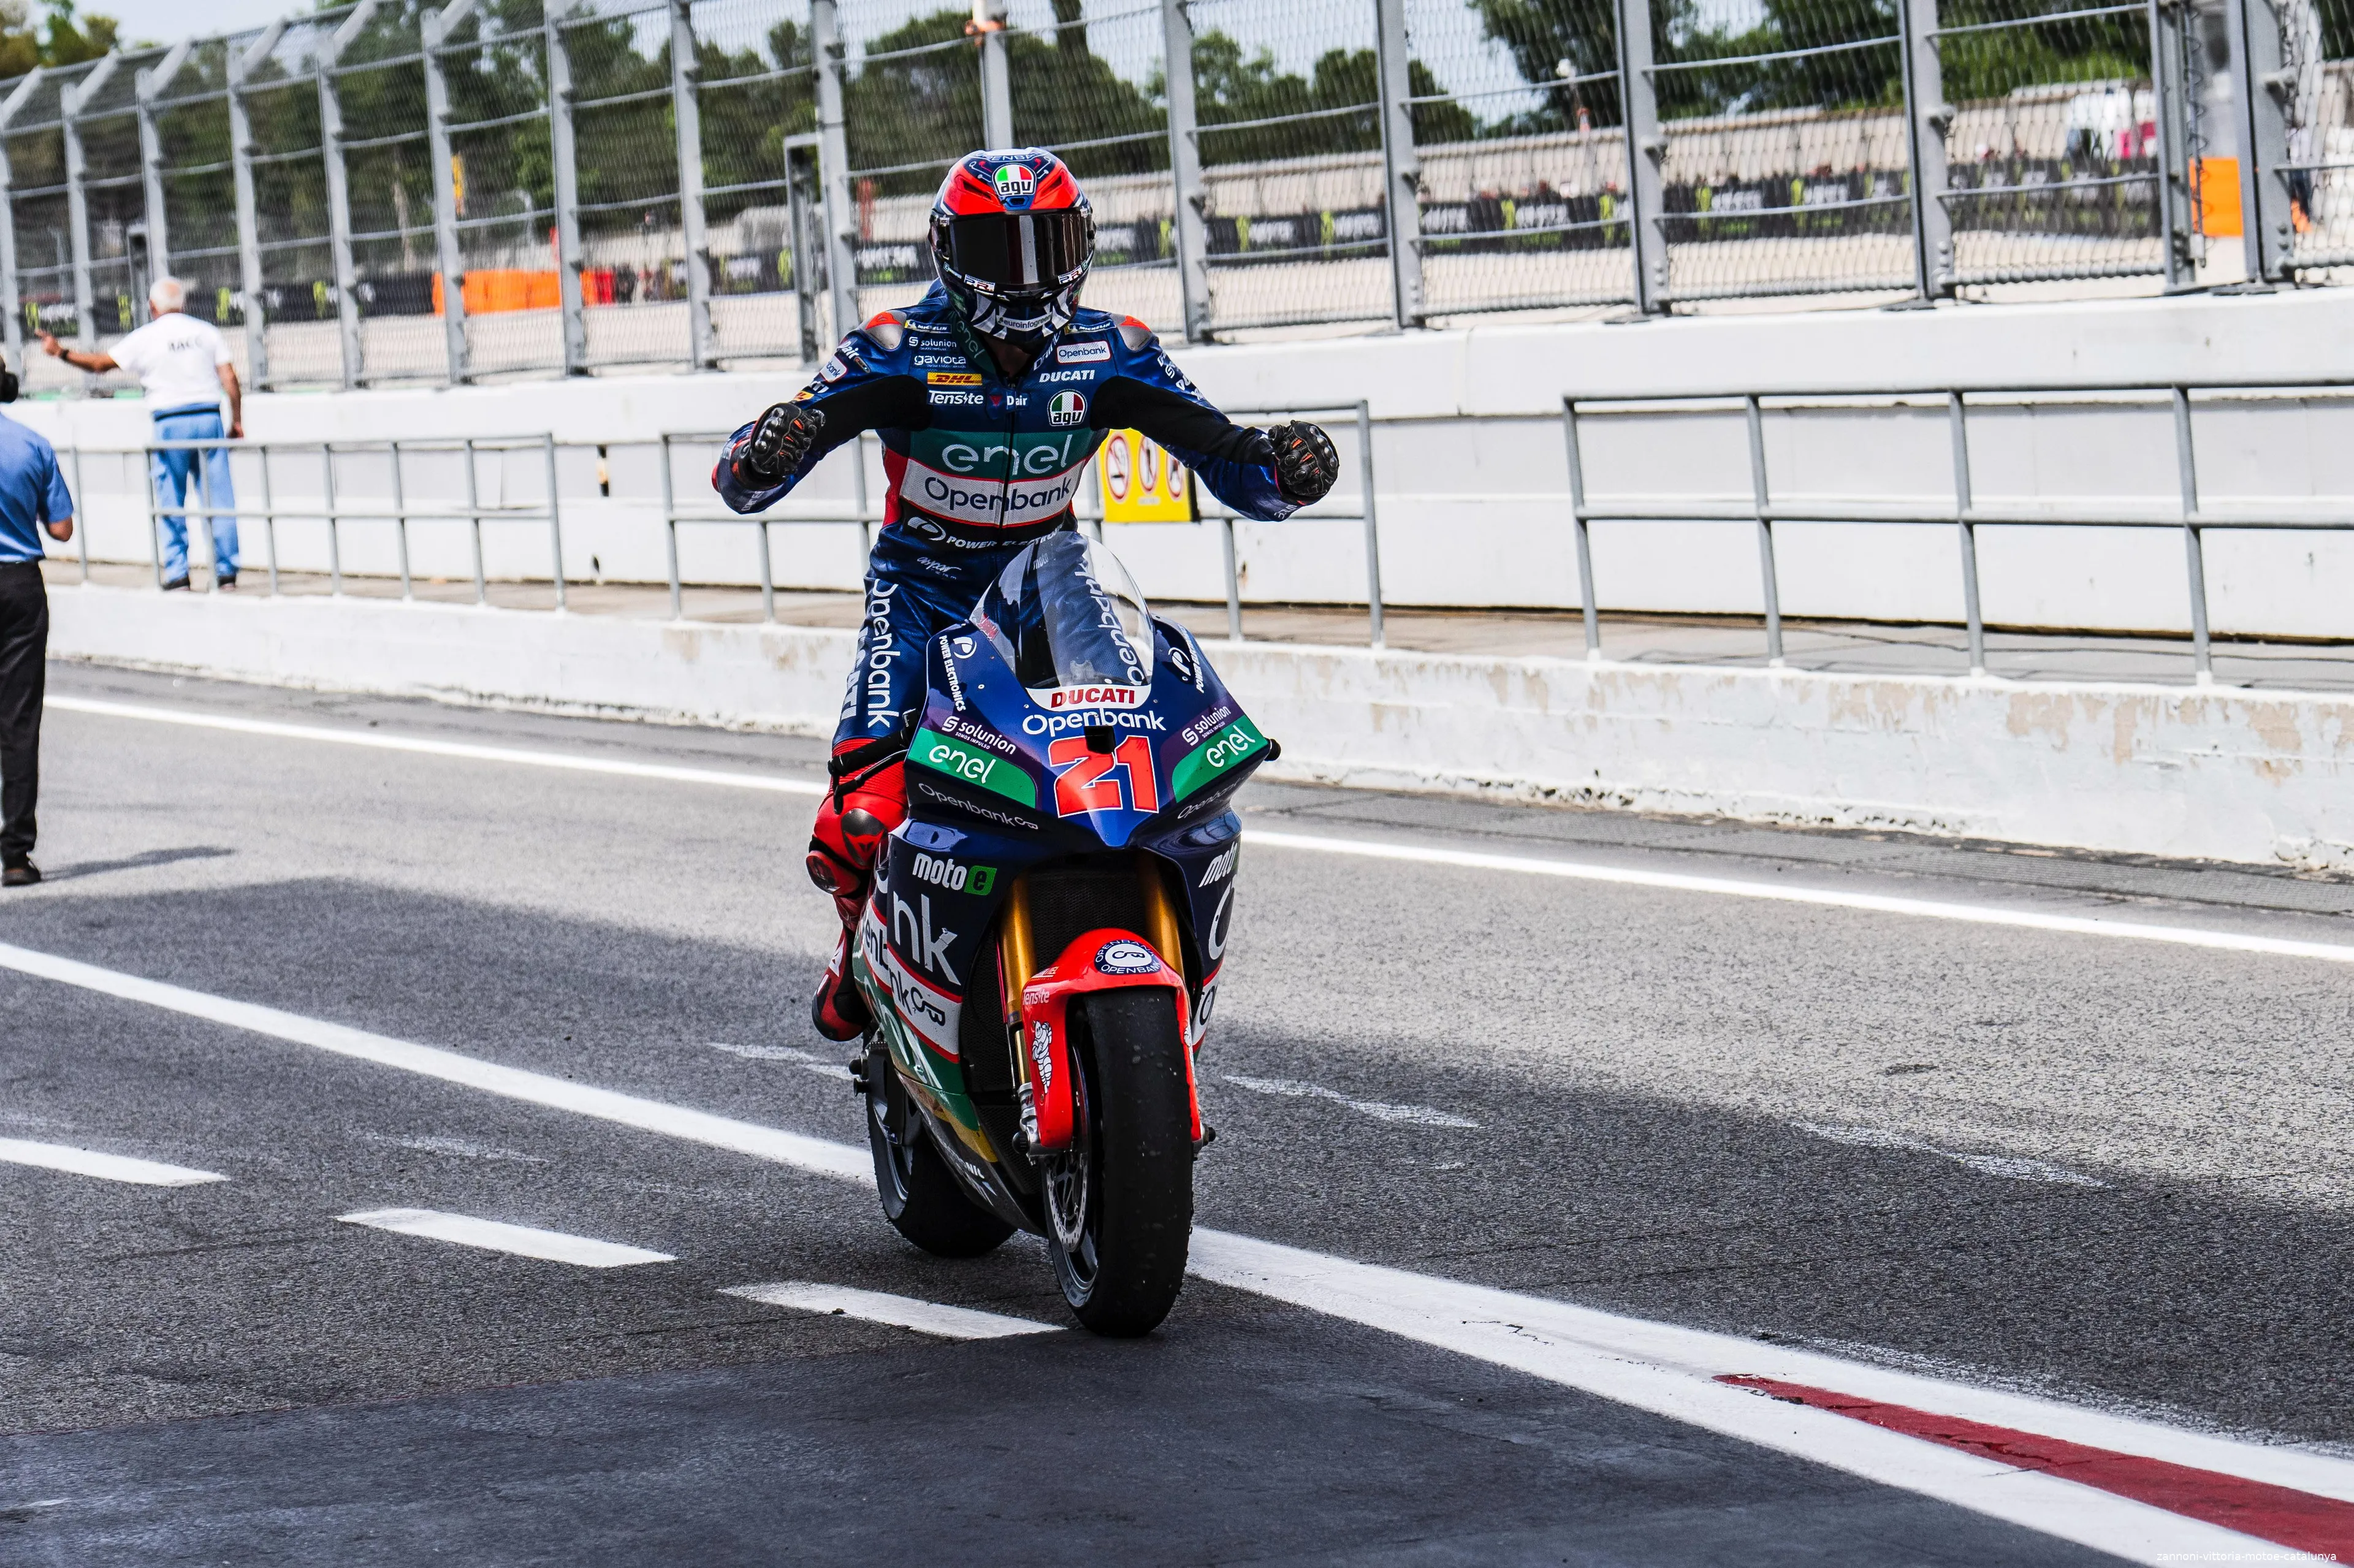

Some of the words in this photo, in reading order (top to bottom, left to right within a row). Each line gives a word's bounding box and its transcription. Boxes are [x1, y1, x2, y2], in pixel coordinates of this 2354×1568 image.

[1000, 181, 1031, 194] agv
[1003, 313, 1051, 329] euroinfogreen
[1079, 322, 1110, 331] MICHELIN
[920, 338, 957, 348] solunion
[956, 320, 985, 359] enel
[1059, 346, 1107, 359] Openbank
[826, 360, 840, 378] bank
[935, 375, 974, 383] DHL
[1039, 370, 1095, 382] DUCATI
[1053, 411, 1082, 424] agv
[942, 434, 1072, 476] enel
[925, 476, 1072, 511] Openbank
[947, 536, 997, 549] POWER
[1075, 563, 1145, 686] penbank
[867, 578, 901, 728] Openbank
[939, 635, 951, 660] POWER
[944, 657, 967, 712] ELECTRONICS
[1193, 662, 1205, 694] POWER
[1051, 688, 1135, 709] DUCATI
[1022, 707, 1167, 737] Openbank
[1195, 706, 1232, 734] solunion
[955, 731, 970, 741] SOMOS
[970, 737, 991, 750] IMPULSO
[958, 721, 1016, 755] solunion
[1206, 725, 1255, 767] enel
[929, 745, 996, 784] enel
[1048, 735, 1159, 818] 21
[918, 782, 1016, 827] Openbank
[1101, 960, 1160, 974] OPENBANK
